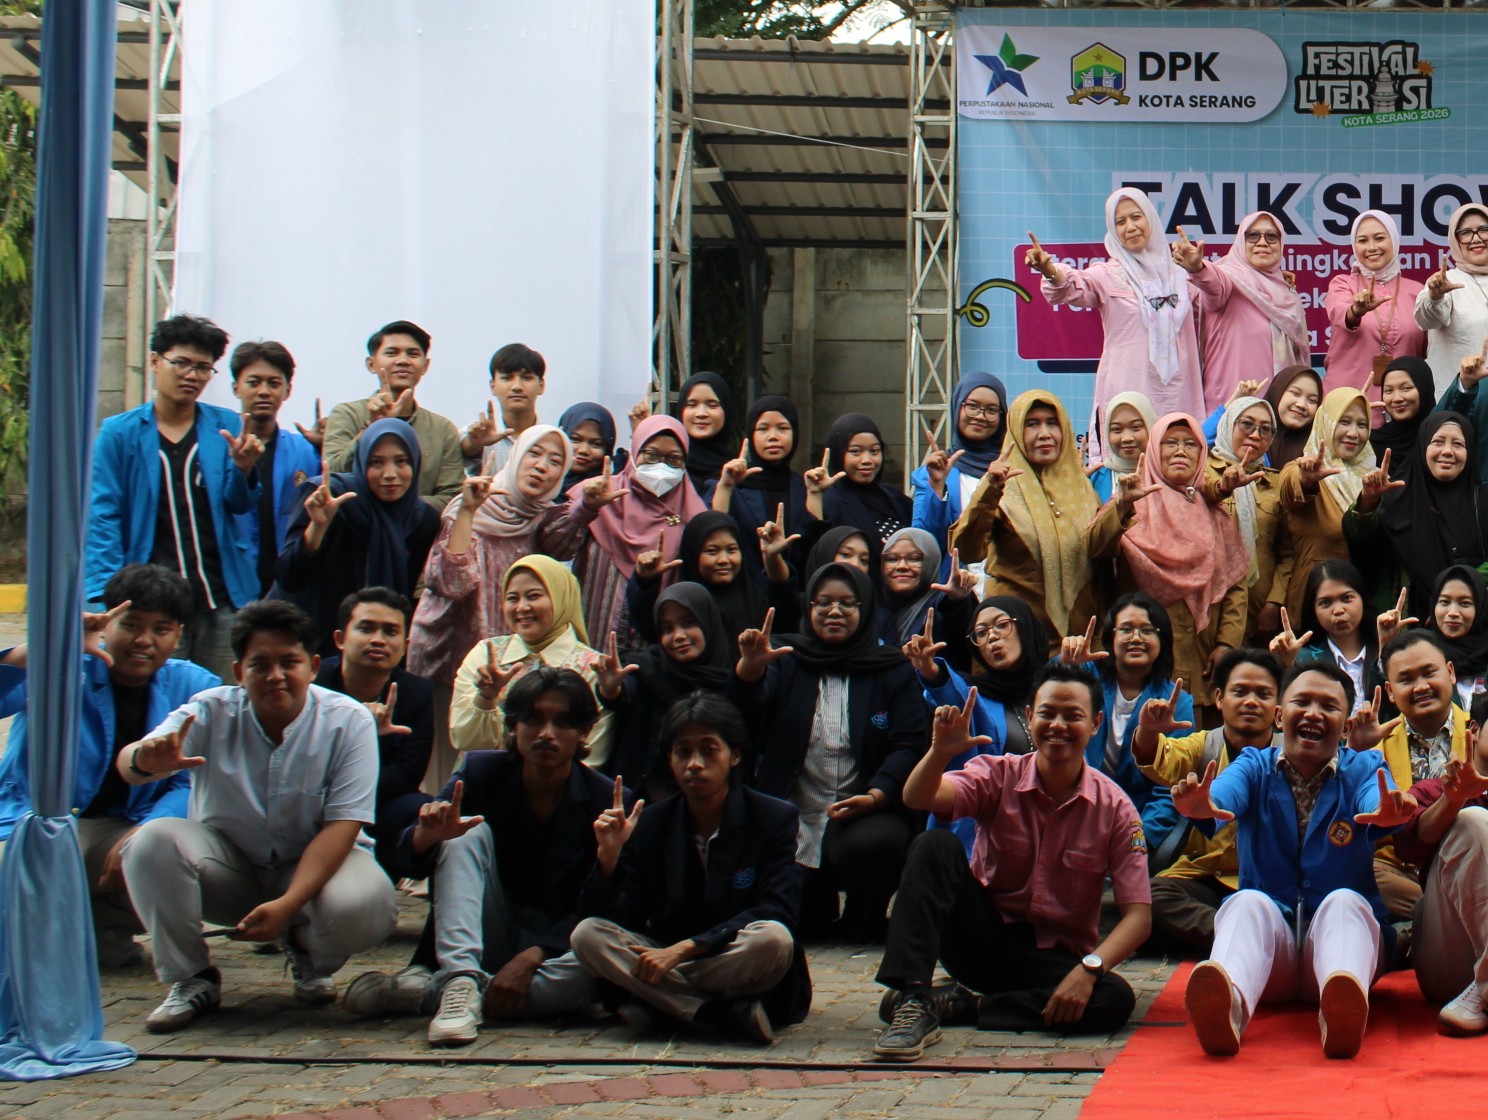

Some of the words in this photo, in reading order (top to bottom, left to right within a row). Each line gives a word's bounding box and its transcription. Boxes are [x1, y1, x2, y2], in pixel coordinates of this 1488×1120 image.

[1138, 51, 1220, 82] DPK
[1306, 45, 1420, 76] FESTIVAL
[959, 100, 1016, 108] PERPUSTAKAAN
[1018, 101, 1055, 109] NASIONAL
[1138, 94, 1185, 108] KOTA
[1188, 95, 1257, 108] SERANG
[1299, 78, 1427, 110] LITERSI
[1344, 116, 1374, 126] KOTA
[1375, 111, 1418, 124] SERANG
[1420, 108, 1449, 120] 2026
[1121, 181, 1303, 236] TALK
